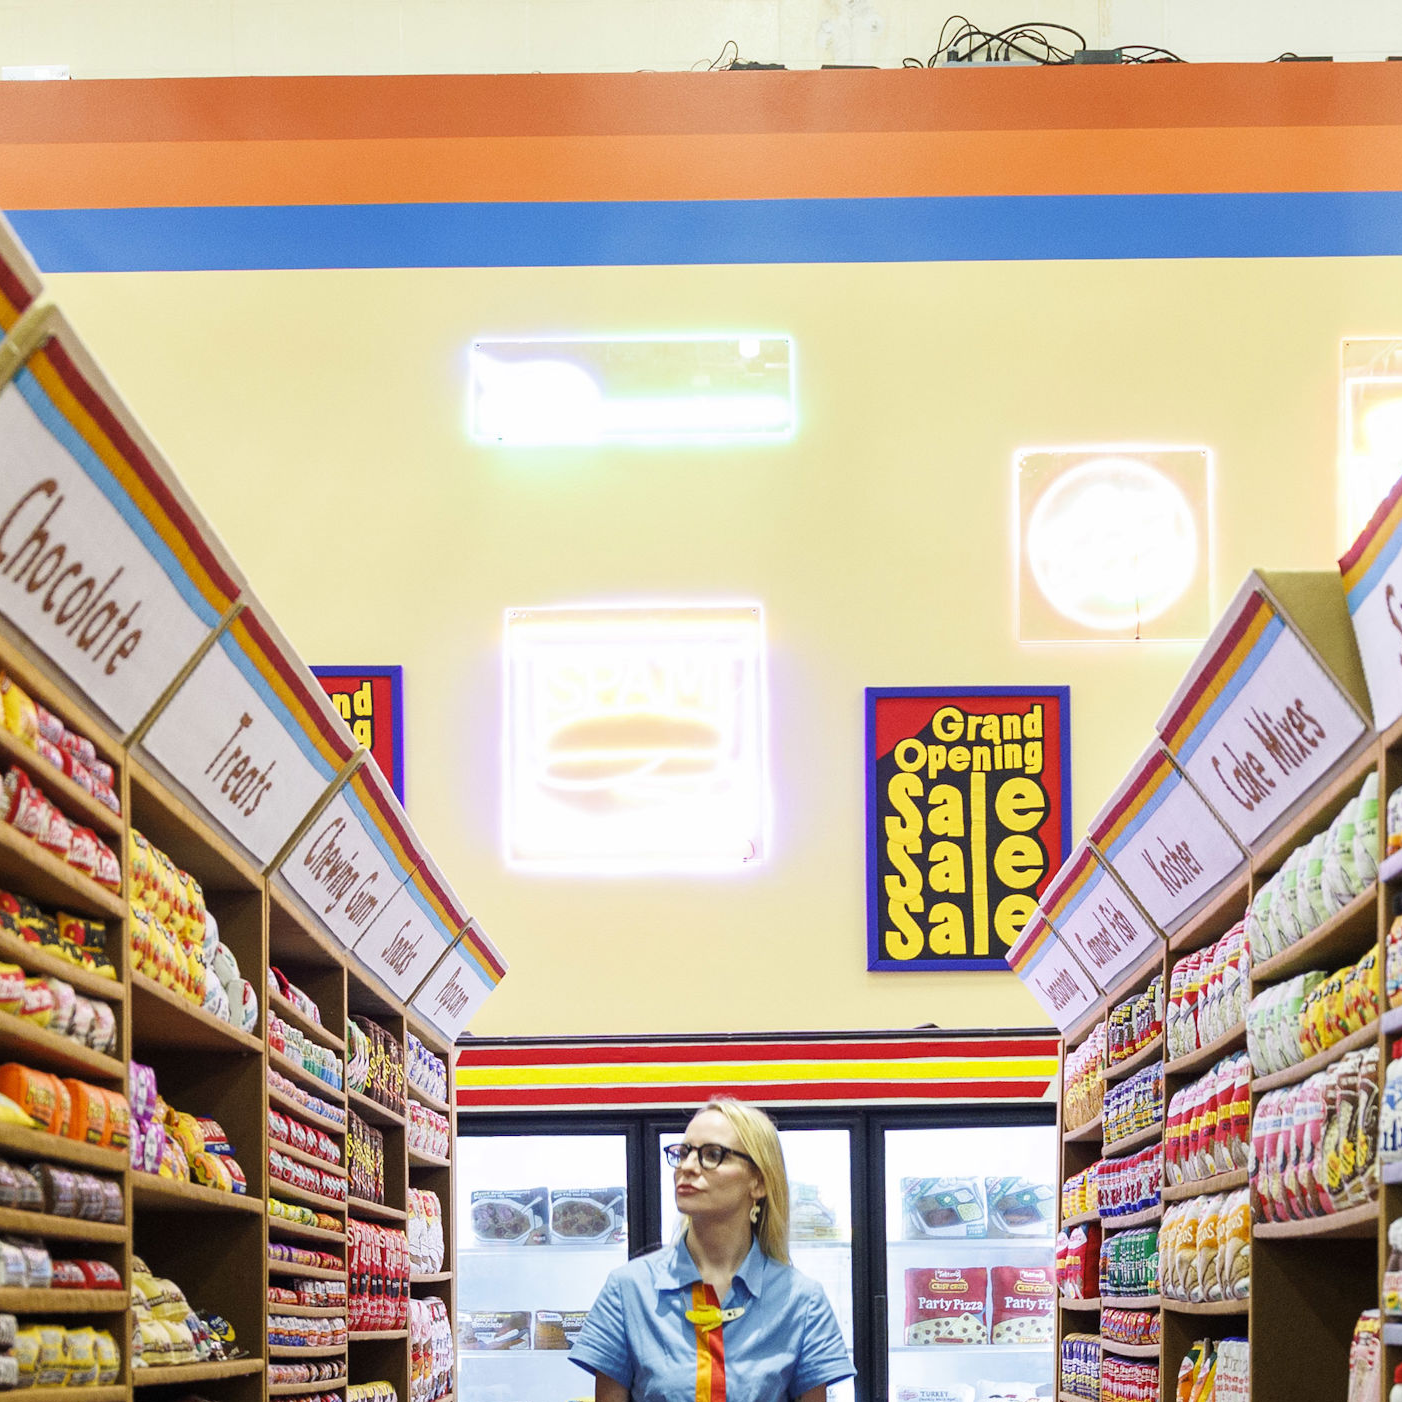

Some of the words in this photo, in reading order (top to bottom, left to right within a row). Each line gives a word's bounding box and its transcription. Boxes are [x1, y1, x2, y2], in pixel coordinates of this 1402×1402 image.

[932, 705, 1043, 744] Grand
[1211, 744, 1276, 812] Cake
[1246, 698, 1326, 776] Mixes
[204, 712, 274, 818] Treats
[894, 738, 1043, 779] Opening
[884, 772, 1045, 844] Sale
[304, 817, 359, 914] Chewing
[345, 872, 378, 927] Gum
[884, 832, 1044, 902] Sale
[1141, 837, 1204, 897] Kosher
[381, 920, 423, 976] Snacks
[884, 893, 1040, 960] Sale
[1075, 905, 1121, 968] Canned
[433, 967, 469, 1018] Popcorn
[918, 1297, 952, 1311] Party
[953, 1299, 983, 1311] Pizza
[1004, 1296, 1036, 1311] Party
[1037, 1298, 1054, 1311] Piz
